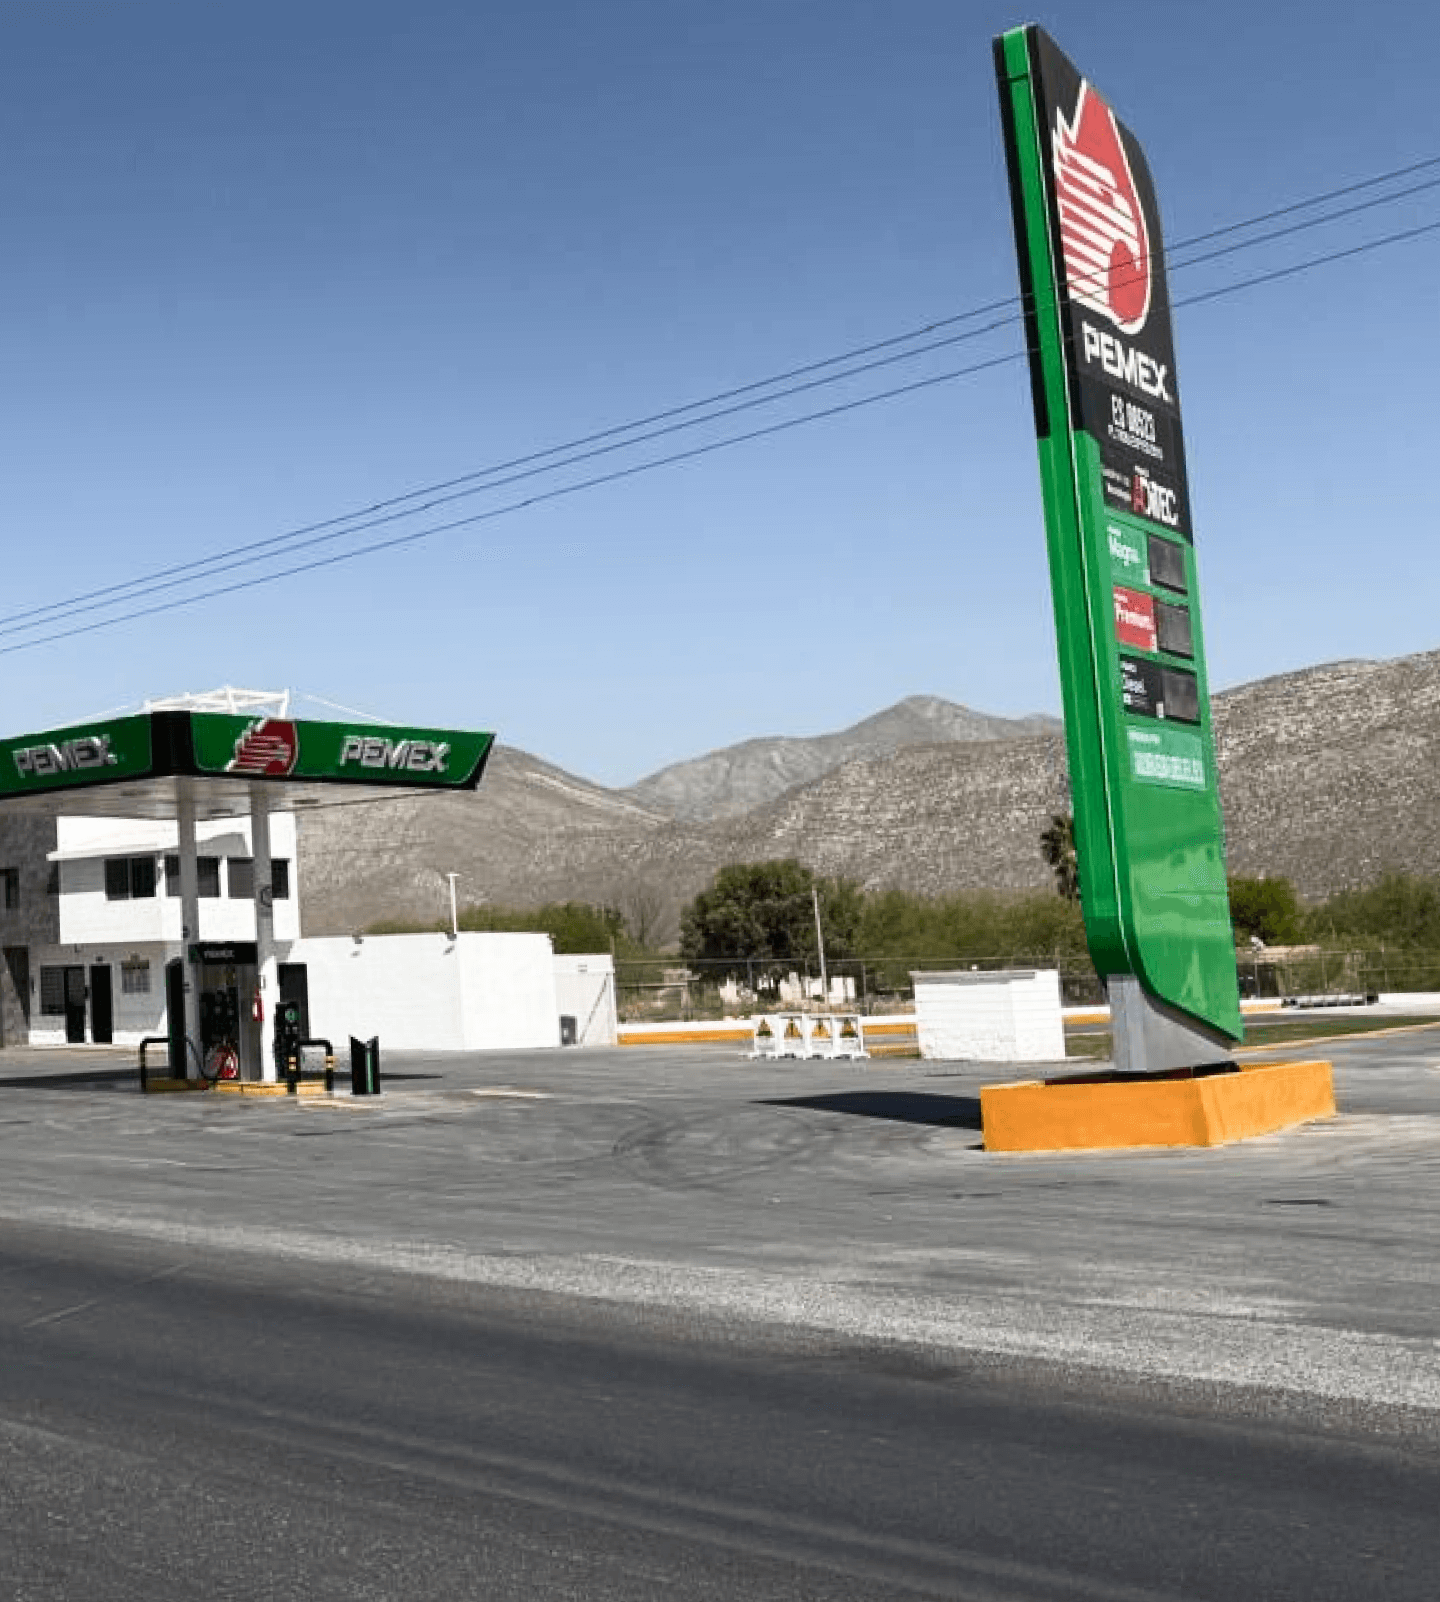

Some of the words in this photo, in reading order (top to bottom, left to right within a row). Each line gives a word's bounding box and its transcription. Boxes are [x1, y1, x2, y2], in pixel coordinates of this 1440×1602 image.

[1081, 320, 1174, 404] PEMEX
[11, 733, 118, 779] PEMEX
[339, 735, 451, 773] PEMEX
